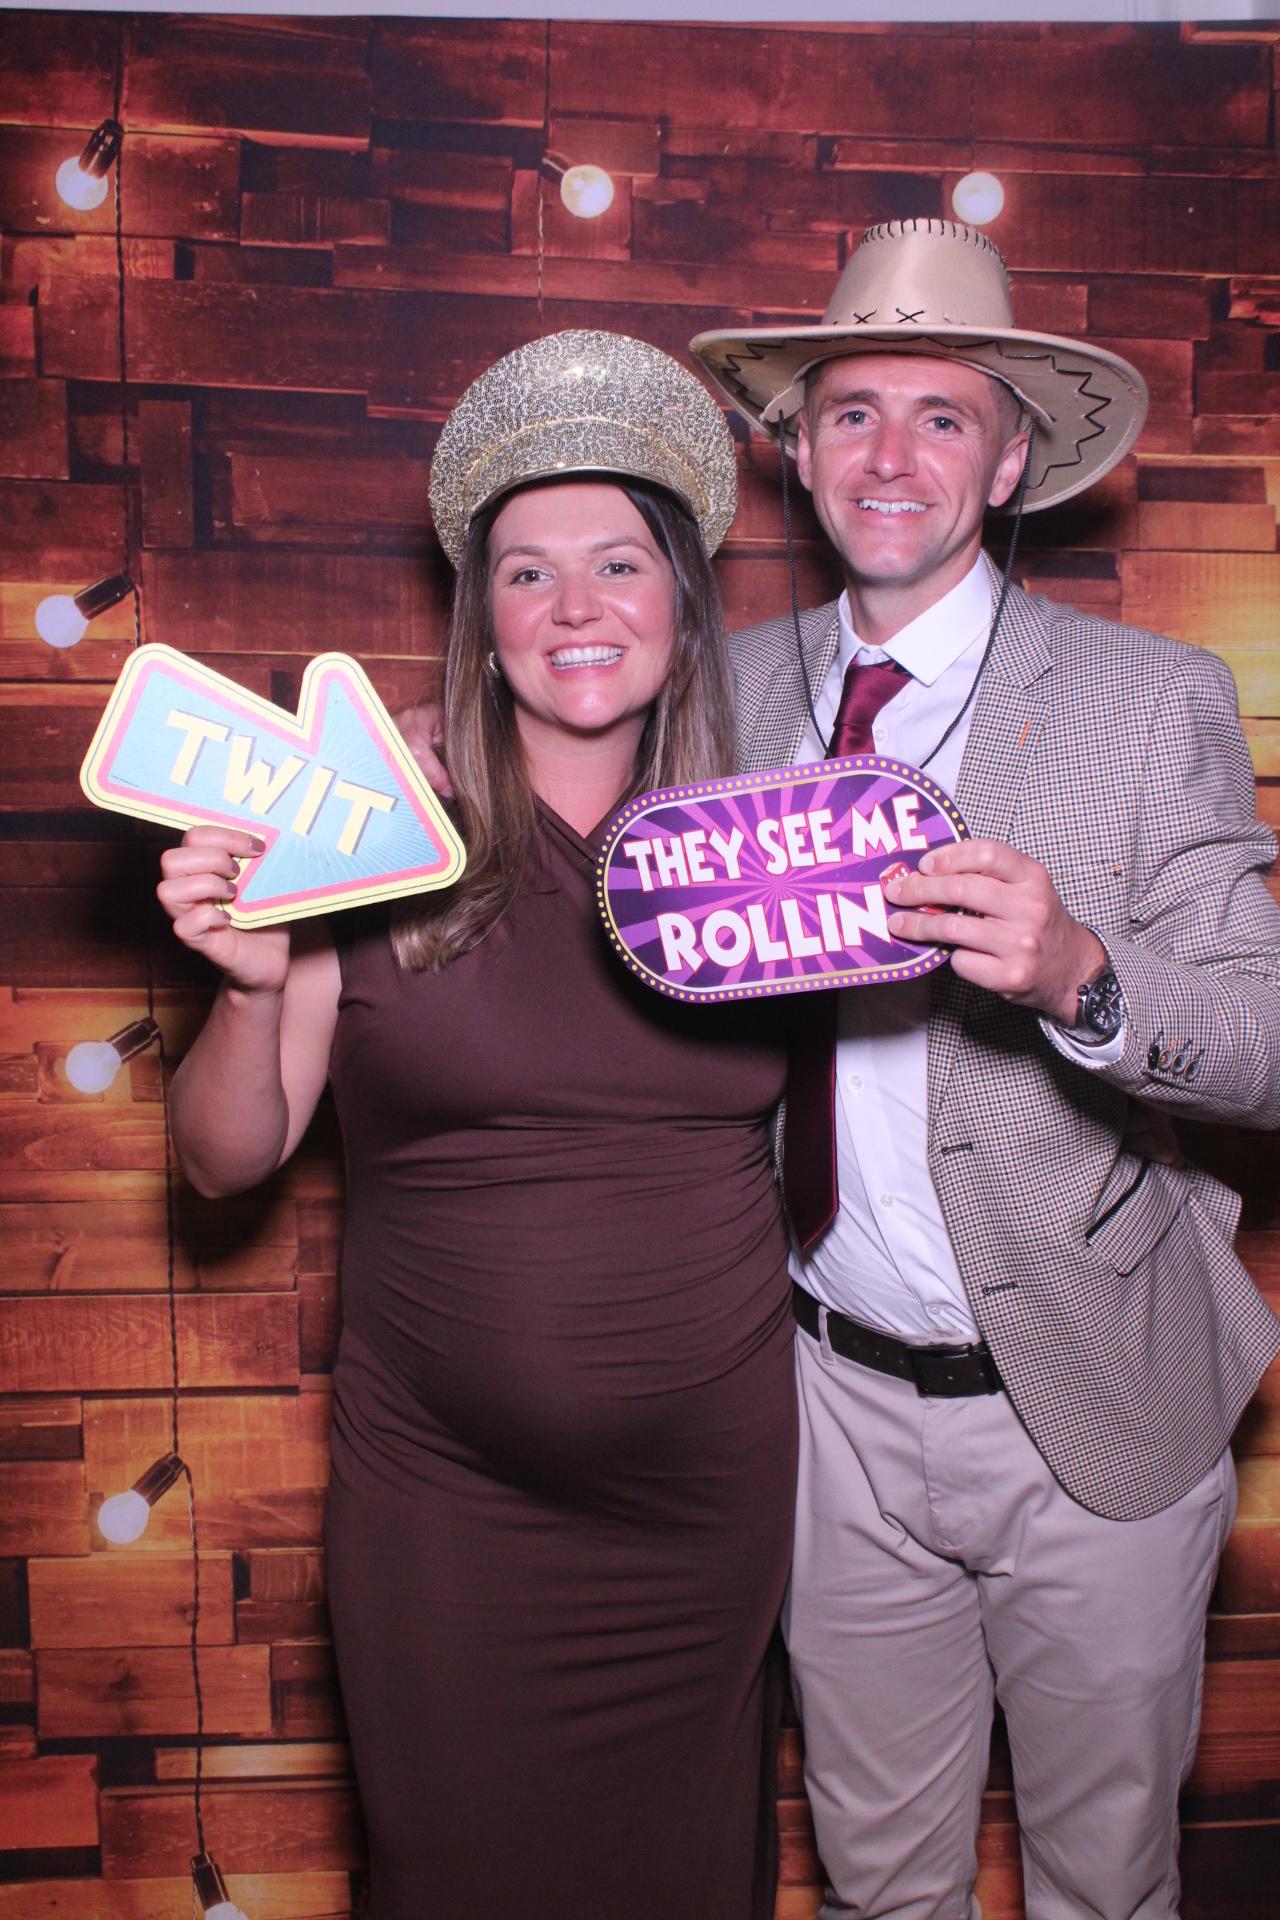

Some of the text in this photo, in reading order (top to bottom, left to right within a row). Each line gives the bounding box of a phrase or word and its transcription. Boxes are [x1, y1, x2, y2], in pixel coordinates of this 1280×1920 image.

[167, 709, 399, 856] TWIT
[622, 792, 929, 893] THEY SEE ME
[656, 883, 893, 973] ROLLIN
